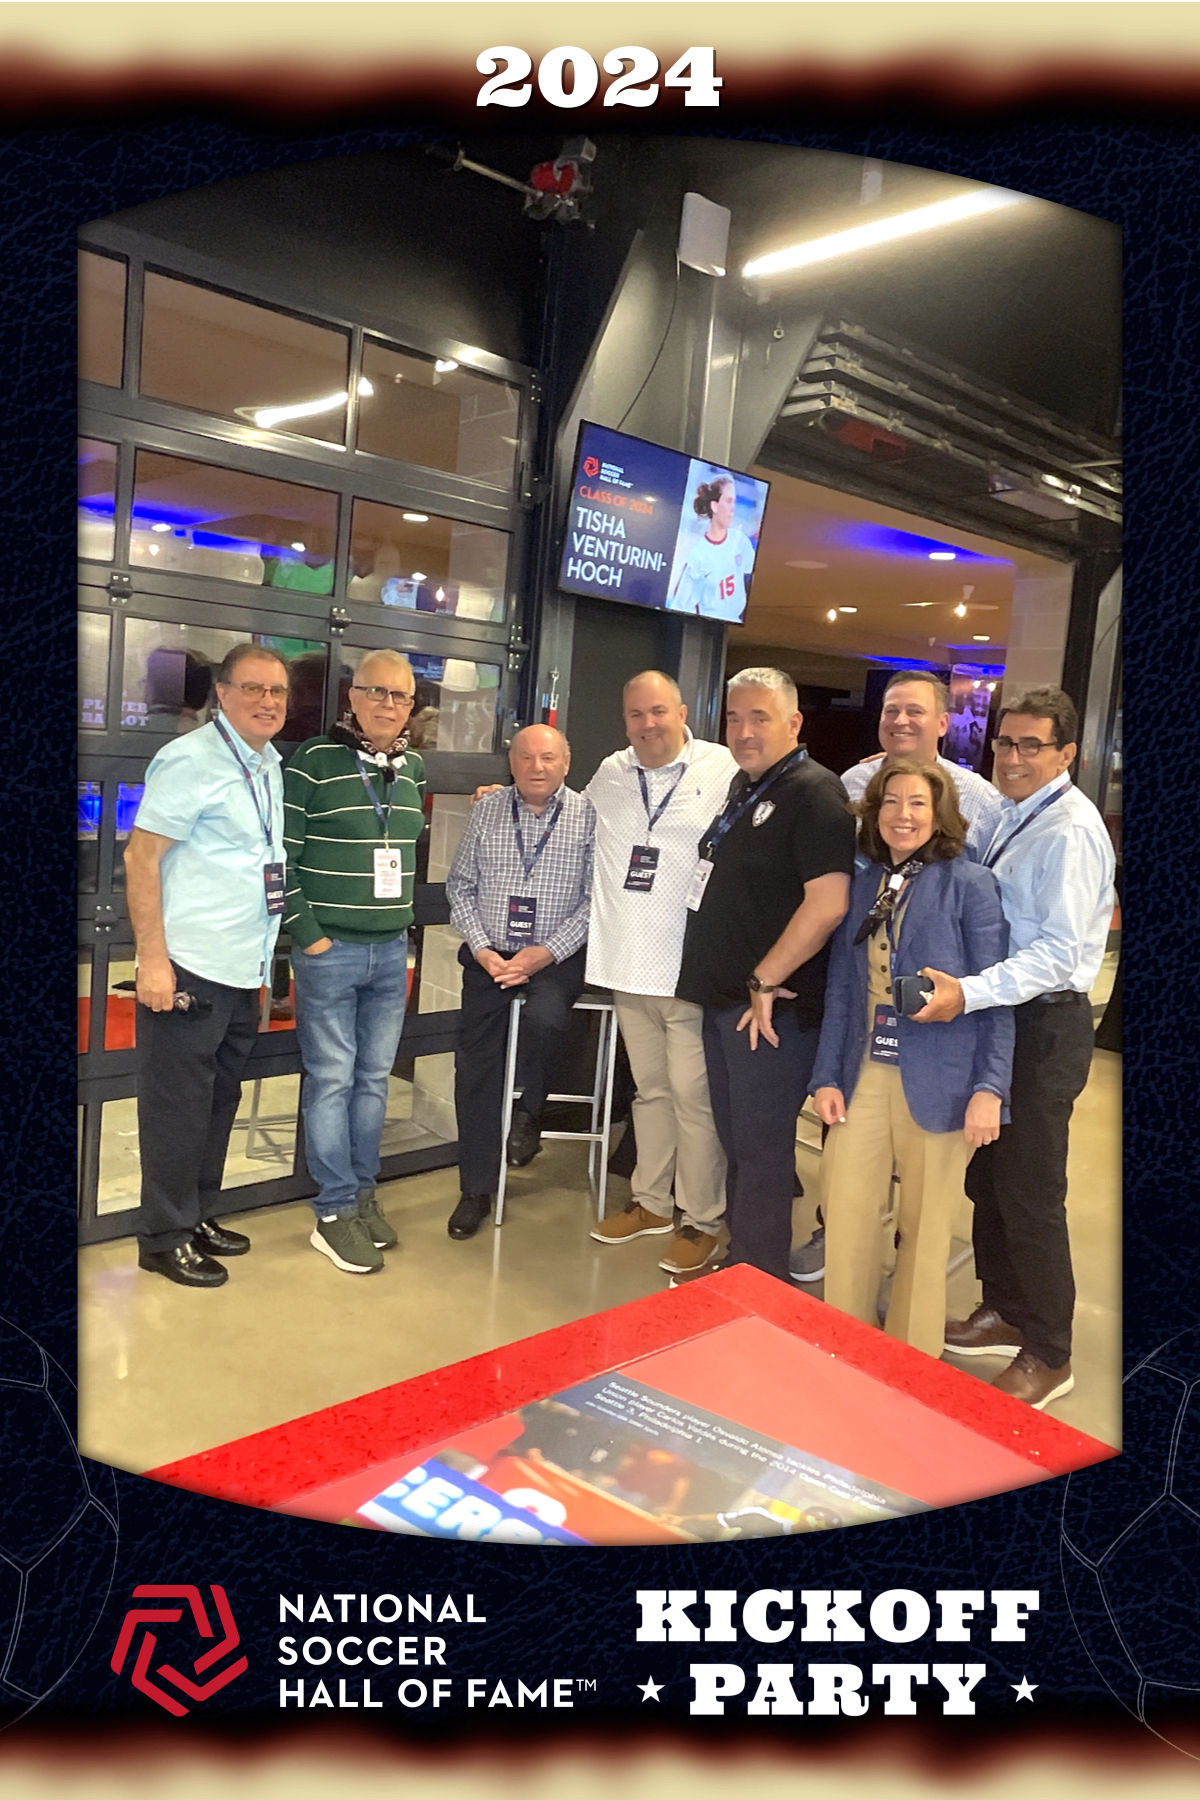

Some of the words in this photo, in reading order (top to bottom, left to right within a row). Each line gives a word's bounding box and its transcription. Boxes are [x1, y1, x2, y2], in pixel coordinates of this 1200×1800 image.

[579, 485, 612, 505] CLASS
[613, 494, 628, 507] OF
[576, 506, 627, 539] TISHA
[572, 531, 667, 572] VENTURINI-
[567, 557, 623, 588] HOCH
[719, 574, 736, 601] 15
[630, 870, 652, 879] GUEST
[509, 920, 533, 929] GUEST
[875, 1036, 899, 1047] GUES
[593, 1392, 626, 1410] Seattle
[608, 1381, 639, 1399] Seattle
[640, 1395, 682, 1417] Sounders
[682, 1414, 711, 1429] player
